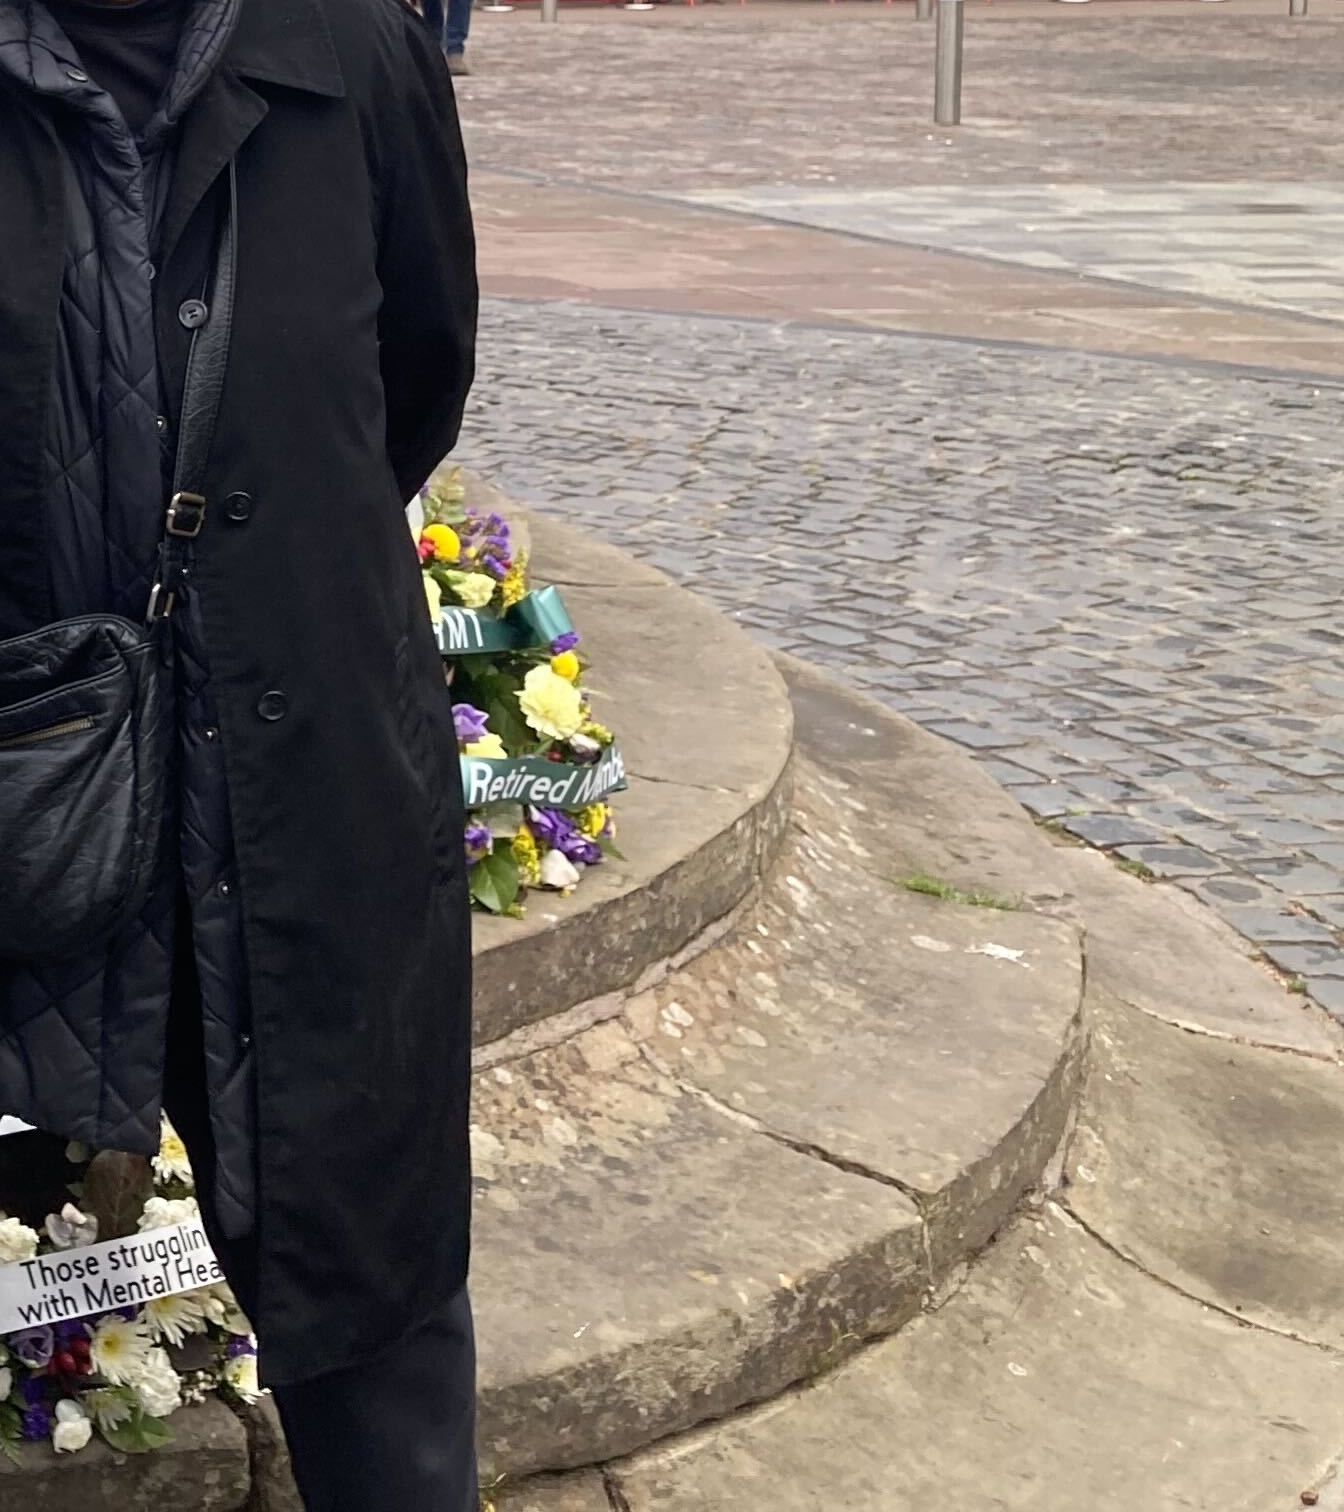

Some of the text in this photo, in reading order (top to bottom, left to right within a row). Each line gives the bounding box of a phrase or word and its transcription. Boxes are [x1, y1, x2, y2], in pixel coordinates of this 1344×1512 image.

[469, 761, 578, 805] Retired
[19, 1225, 207, 1291] Those strugglin
[18, 1258, 221, 1325] with Mental Hea
